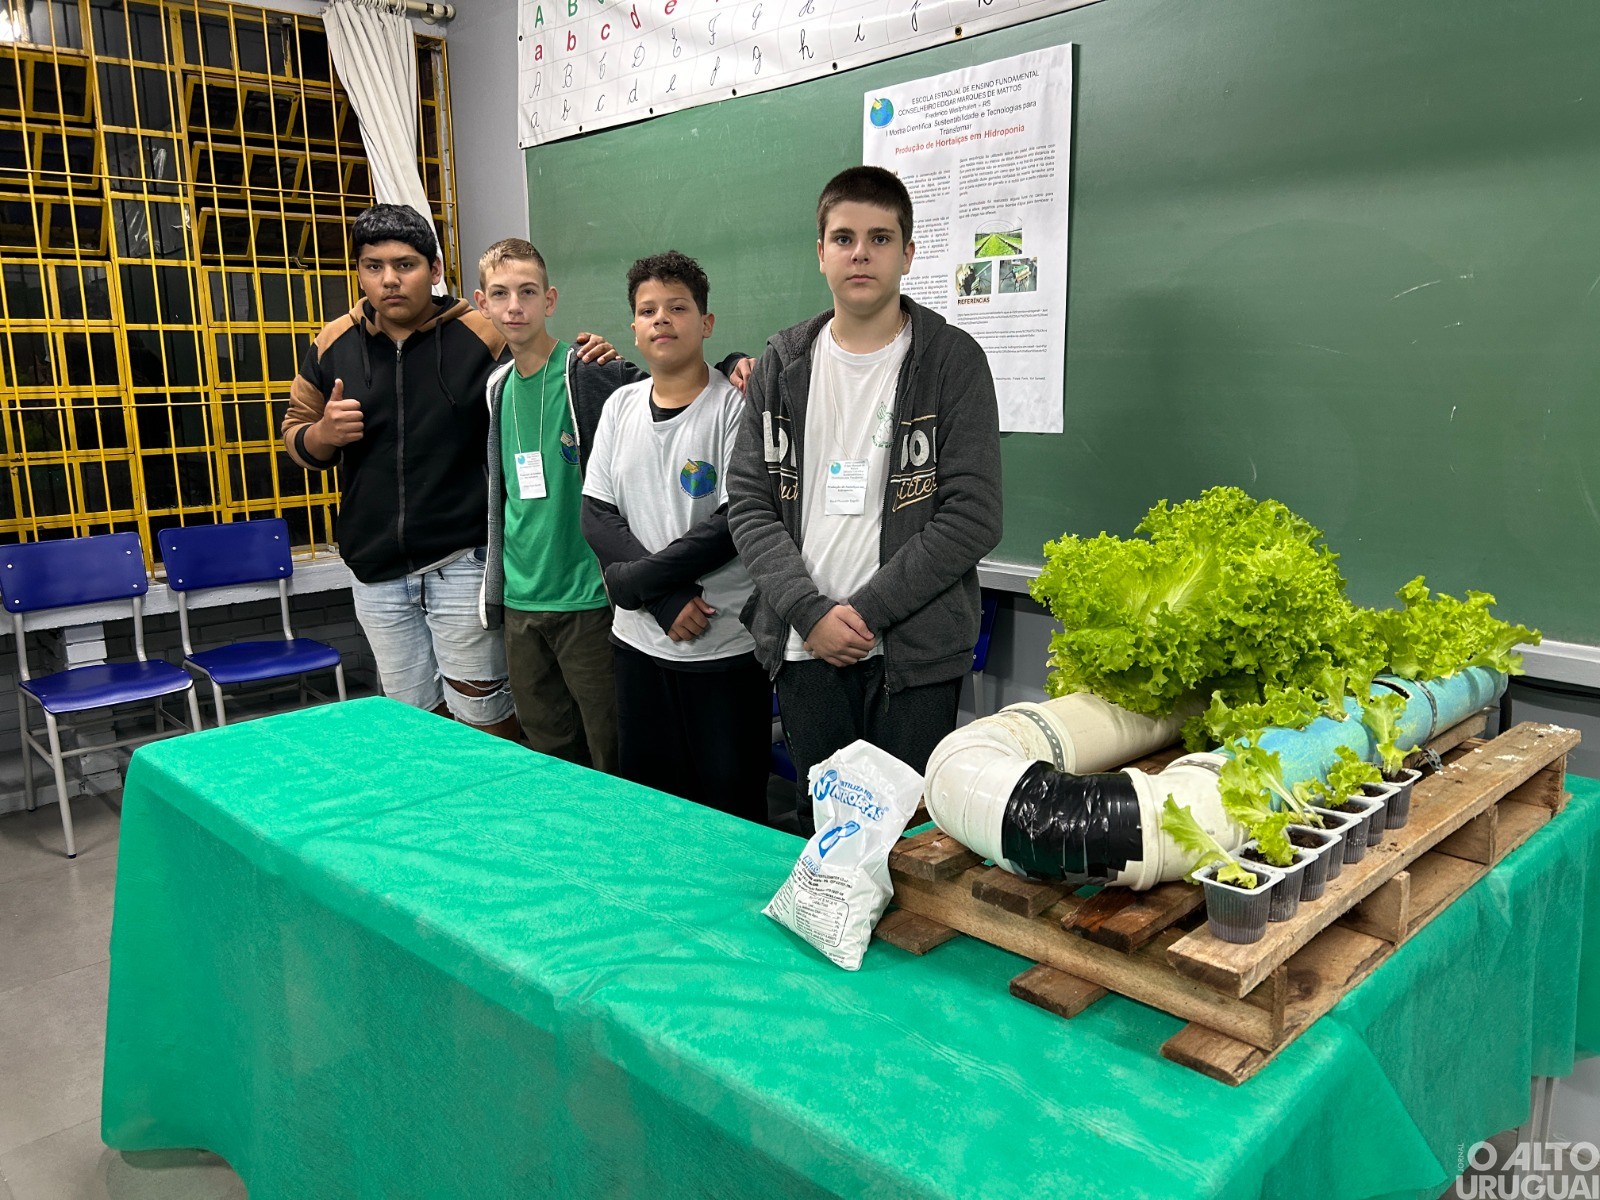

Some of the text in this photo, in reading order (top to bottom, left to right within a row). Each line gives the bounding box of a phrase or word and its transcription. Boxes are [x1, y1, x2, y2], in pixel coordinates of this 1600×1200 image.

[534, 0, 578, 28] A B
[534, 0, 678, 61] a b c d e
[627, 78, 638, 105] d
[798, 28, 815, 60] h
[898, 84, 1022, 116] CONSELHEIRO EDGAR MARQUES DE MATTOS
[912, 69, 1039, 105] ESCOLA ESTADUAL DE ENSINO FUNDAMENTAL
[987, 104, 1022, 118] Tecnologias
[1022, 100, 1037, 111] para
[895, 143, 925, 156] Produção
[925, 141, 934, 150] de
[984, 124, 1025, 139] Hidroponia
